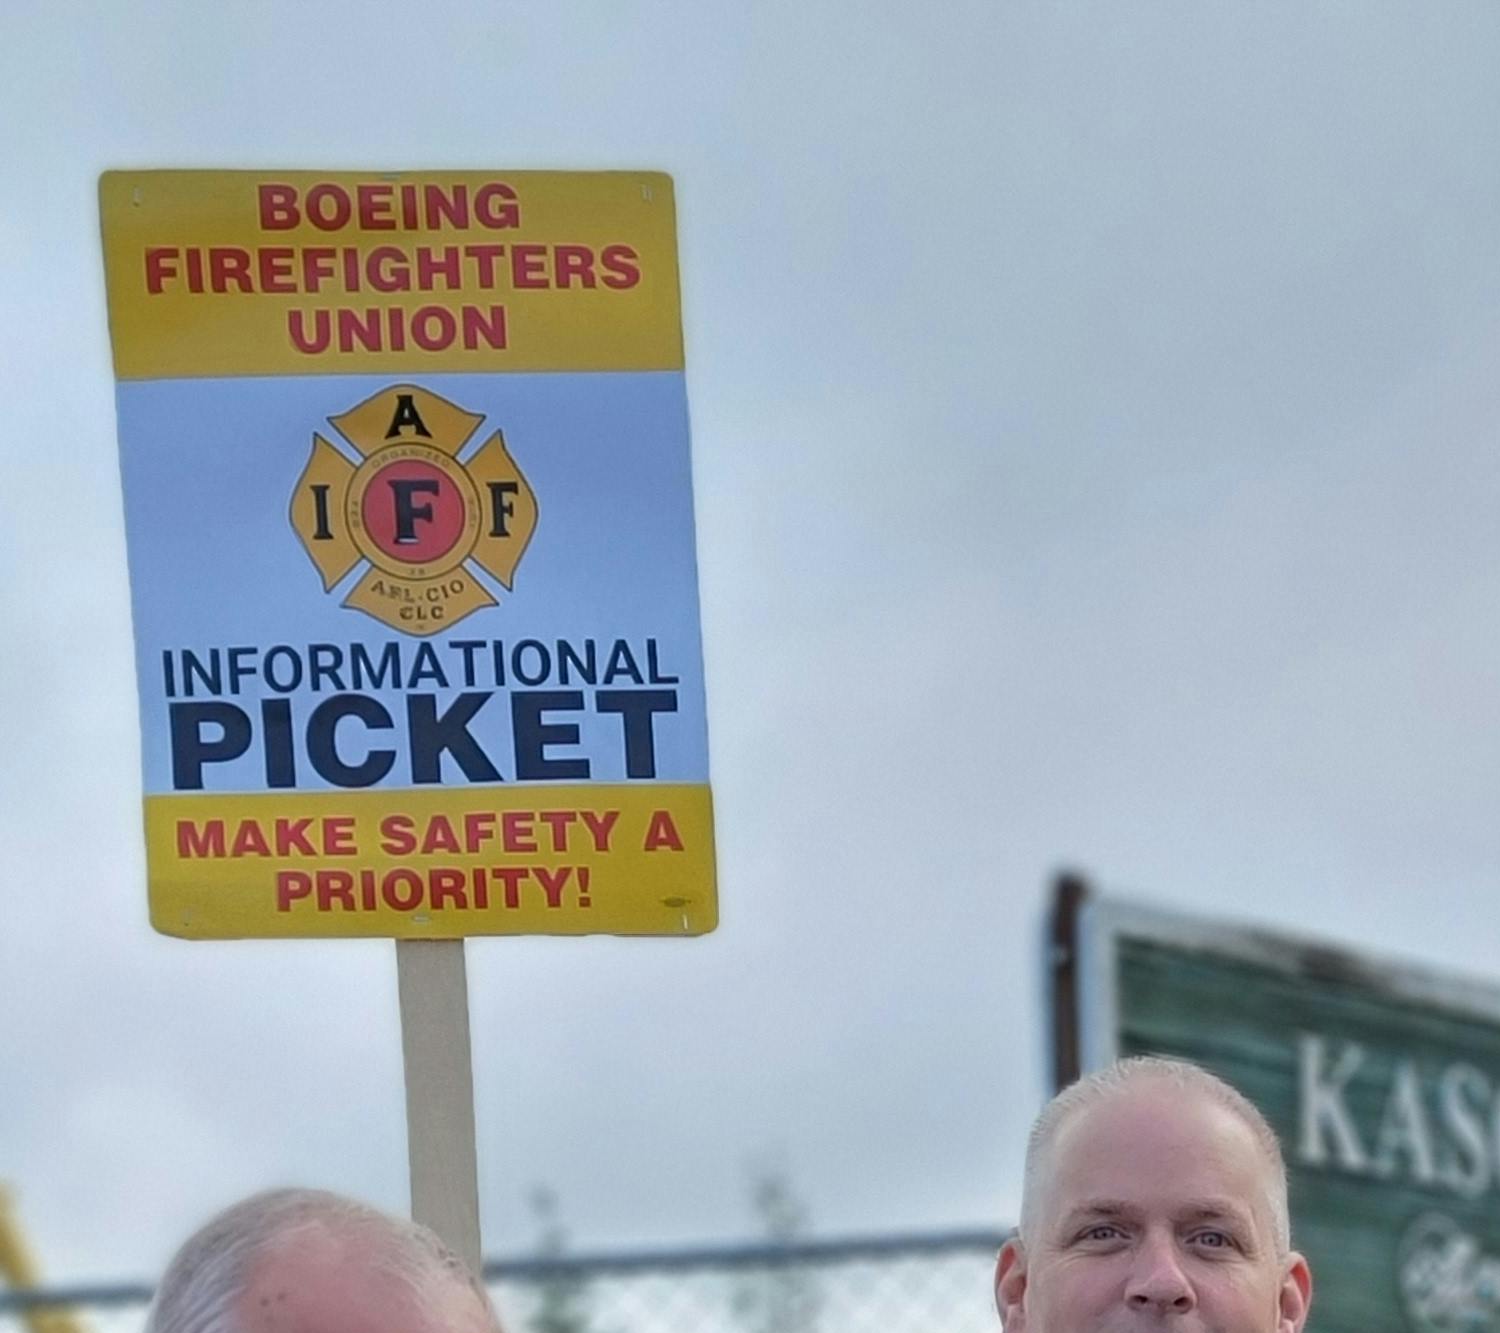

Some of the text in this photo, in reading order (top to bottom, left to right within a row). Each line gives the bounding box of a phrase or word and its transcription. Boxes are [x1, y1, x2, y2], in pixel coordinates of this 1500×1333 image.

[258, 182, 520, 233] BOEING
[145, 245, 641, 295] FIREFIGHTERS
[287, 306, 508, 355] UNION
[385, 394, 433, 440] A
[310, 484, 334, 541] I
[387, 478, 440, 546] F
[486, 481, 519, 538] F
[162, 638, 680, 697] INFORMATIONAL
[168, 690, 679, 791] PICKET
[176, 810, 685, 859] MAKE SAFETY A
[275, 866, 592, 913] PRIORITY!
